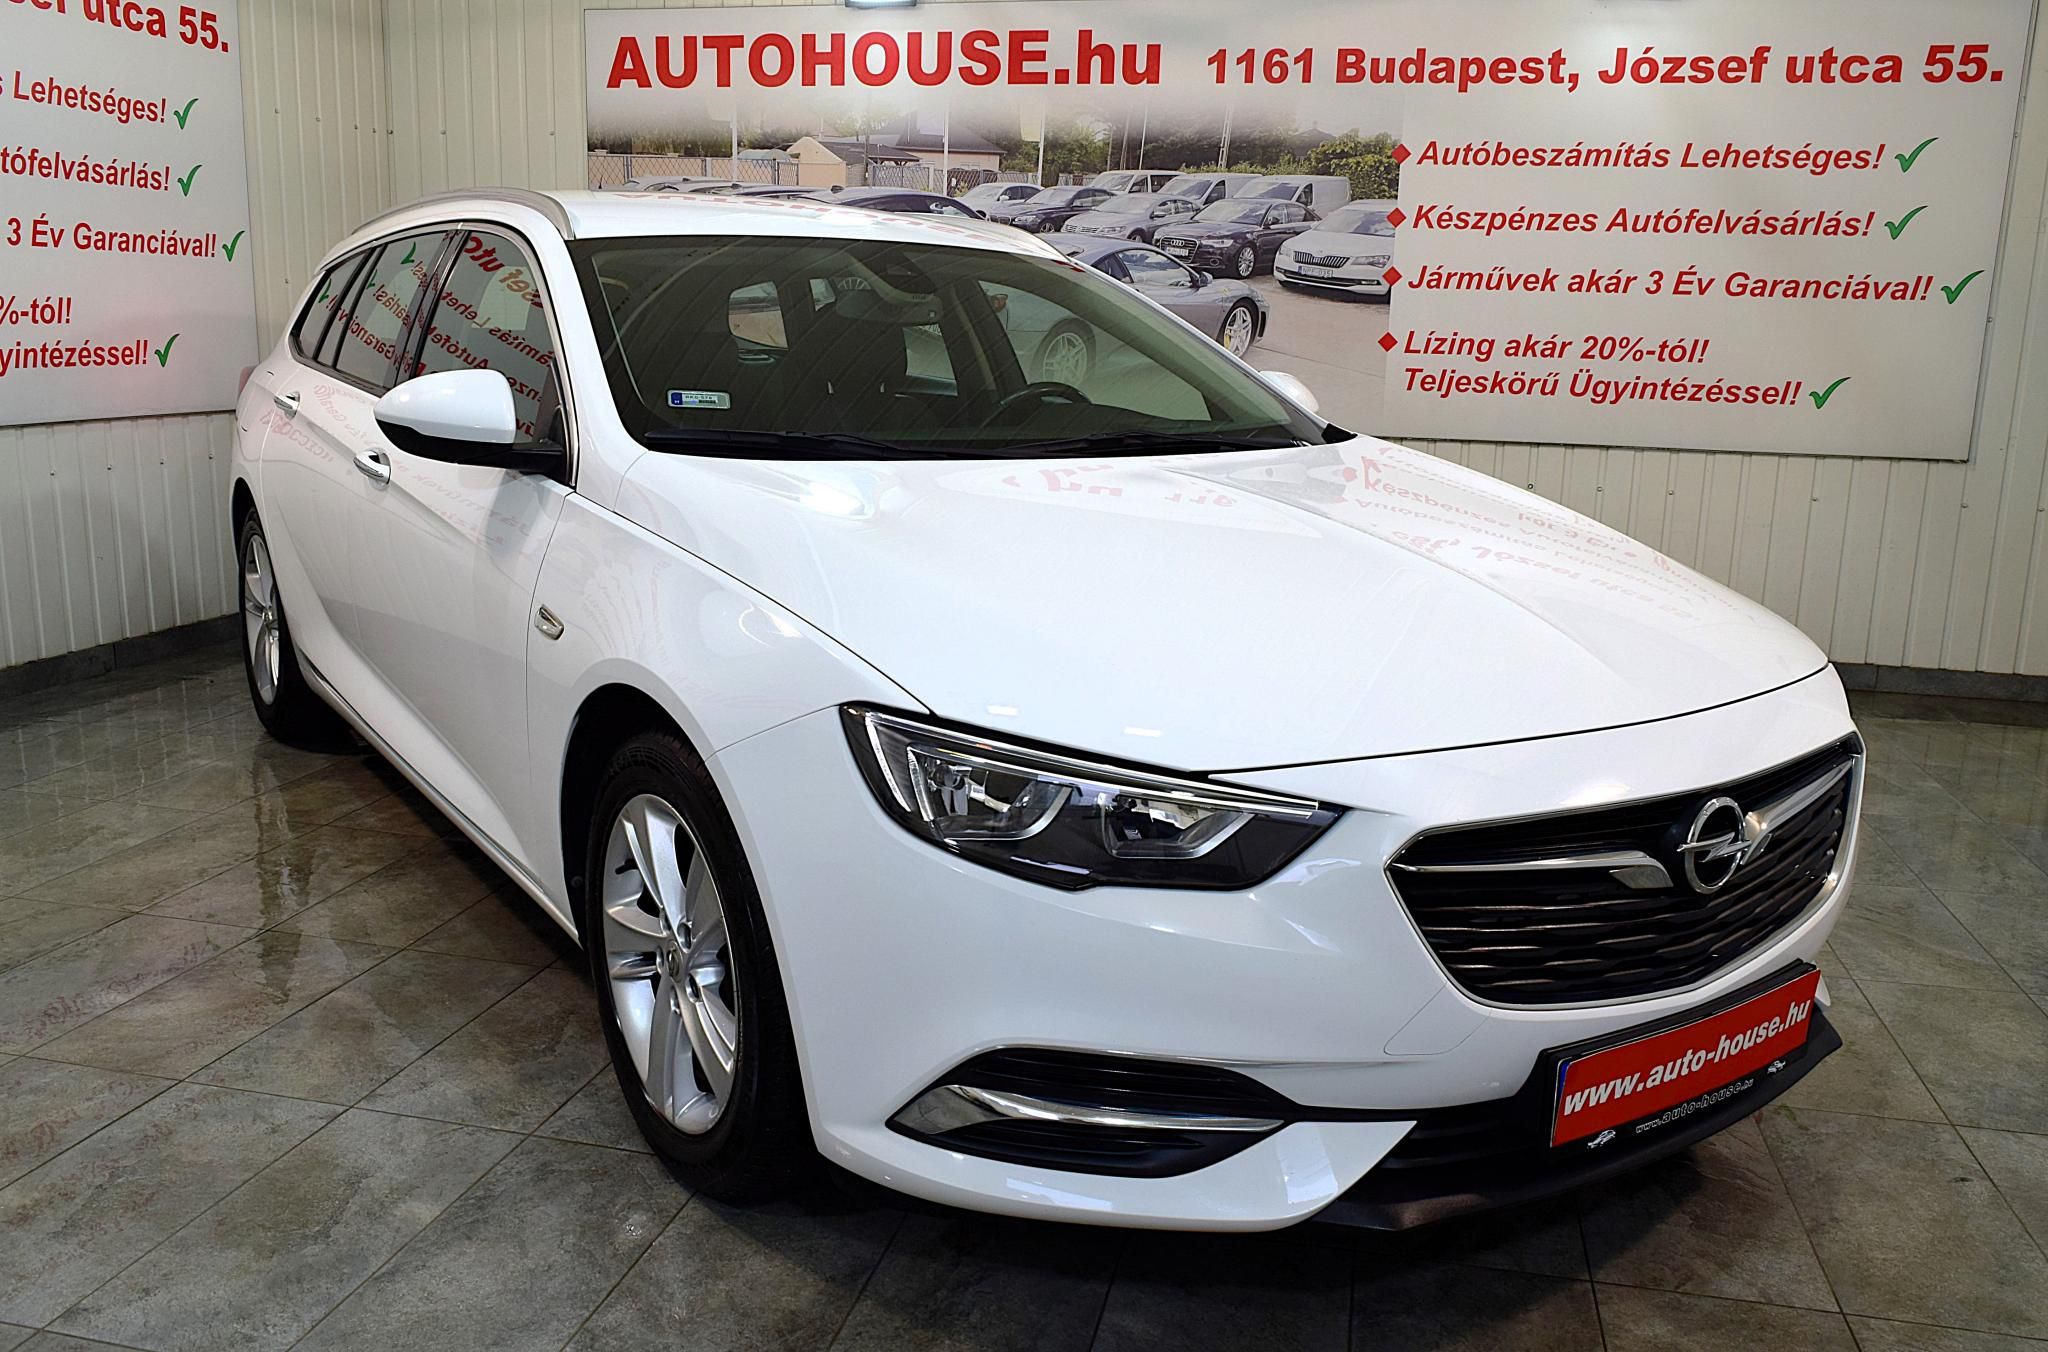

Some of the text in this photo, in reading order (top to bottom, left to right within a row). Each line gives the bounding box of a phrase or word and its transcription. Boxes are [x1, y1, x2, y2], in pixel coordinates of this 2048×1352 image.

[82, 0, 230, 53] utca 55.
[607, 29, 2004, 93] AUTOHOUSE.hu 1161 Budapest, József utca 55.
[13, 70, 167, 124] Lehetséges!
[0, 146, 171, 191] tófelvásárlás!
[1416, 140, 1886, 177] Autóbeszámítás Lehetséges!
[7, 213, 217, 257] 3 Év Garanciával!
[1412, 204, 1876, 237] Készpénzes Autófelvásárlás!
[1408, 265, 1934, 301] Járművek akár 3 Év Garanciával!
[1403, 329, 1710, 363] Lízing akár 20%-tól!
[1404, 367, 1803, 406] Teljeskörű Ügyintézéssel!
[1563, 999, 1811, 1117] www.auto-house.hu
